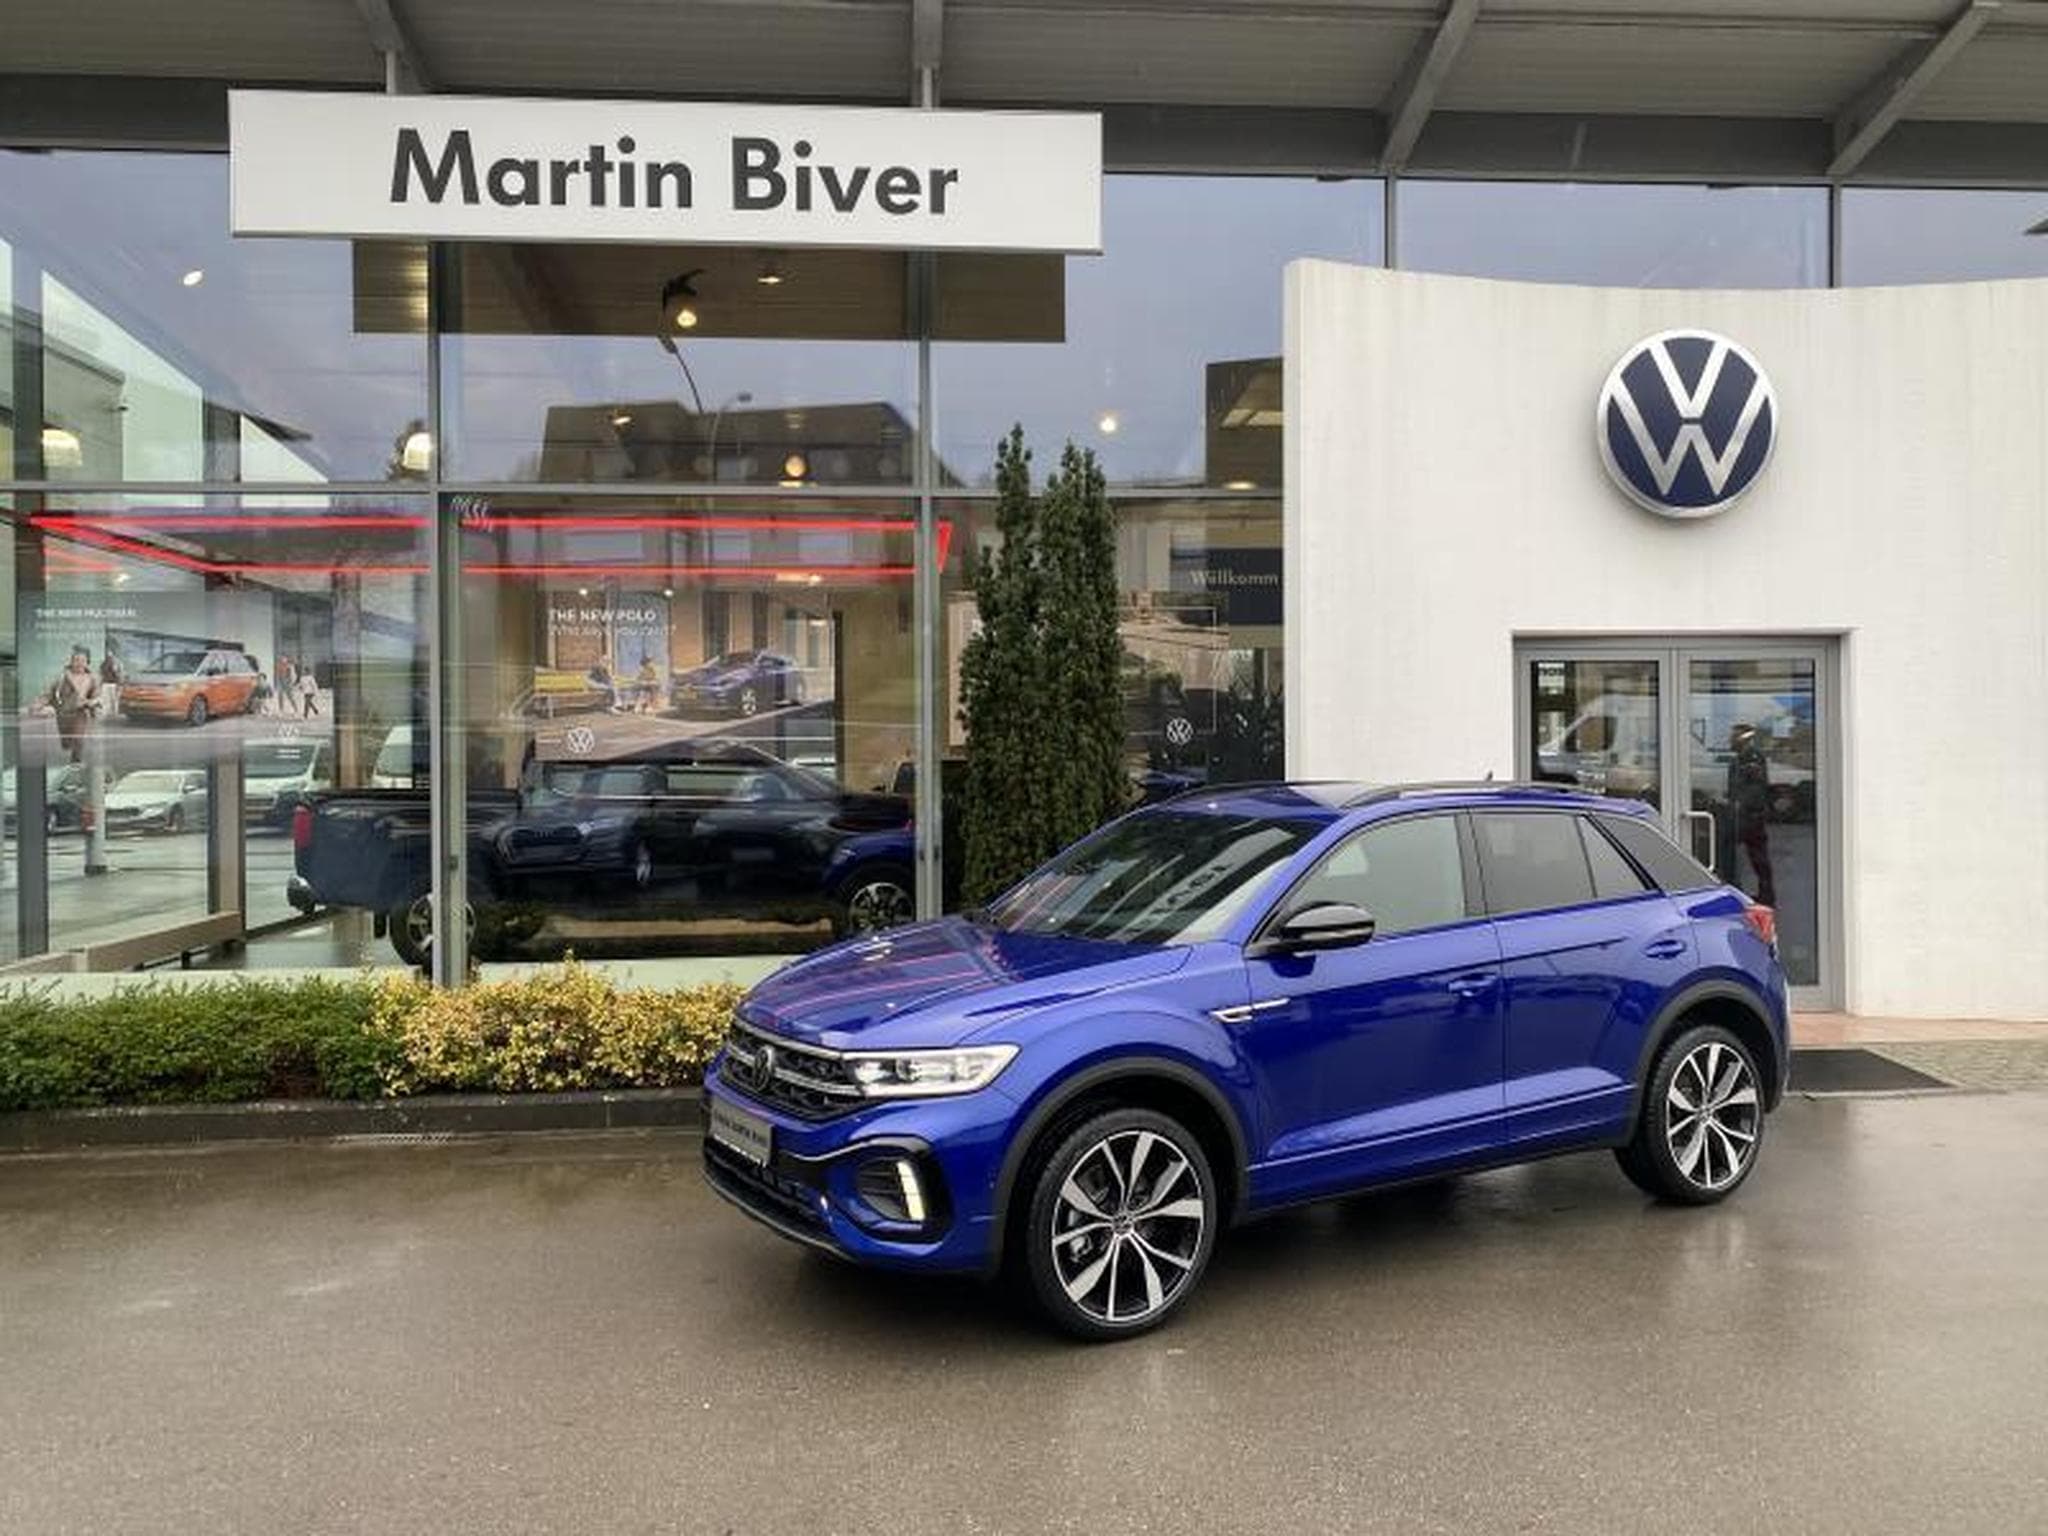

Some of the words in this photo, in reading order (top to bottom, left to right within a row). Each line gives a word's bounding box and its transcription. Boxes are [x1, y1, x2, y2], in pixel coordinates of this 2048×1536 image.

[390, 128, 692, 208] Martin
[732, 137, 958, 215] Biver
[1600, 331, 1776, 516] VW
[549, 608, 575, 620] THE
[580, 608, 614, 621] NEW
[615, 608, 657, 621] POLO
